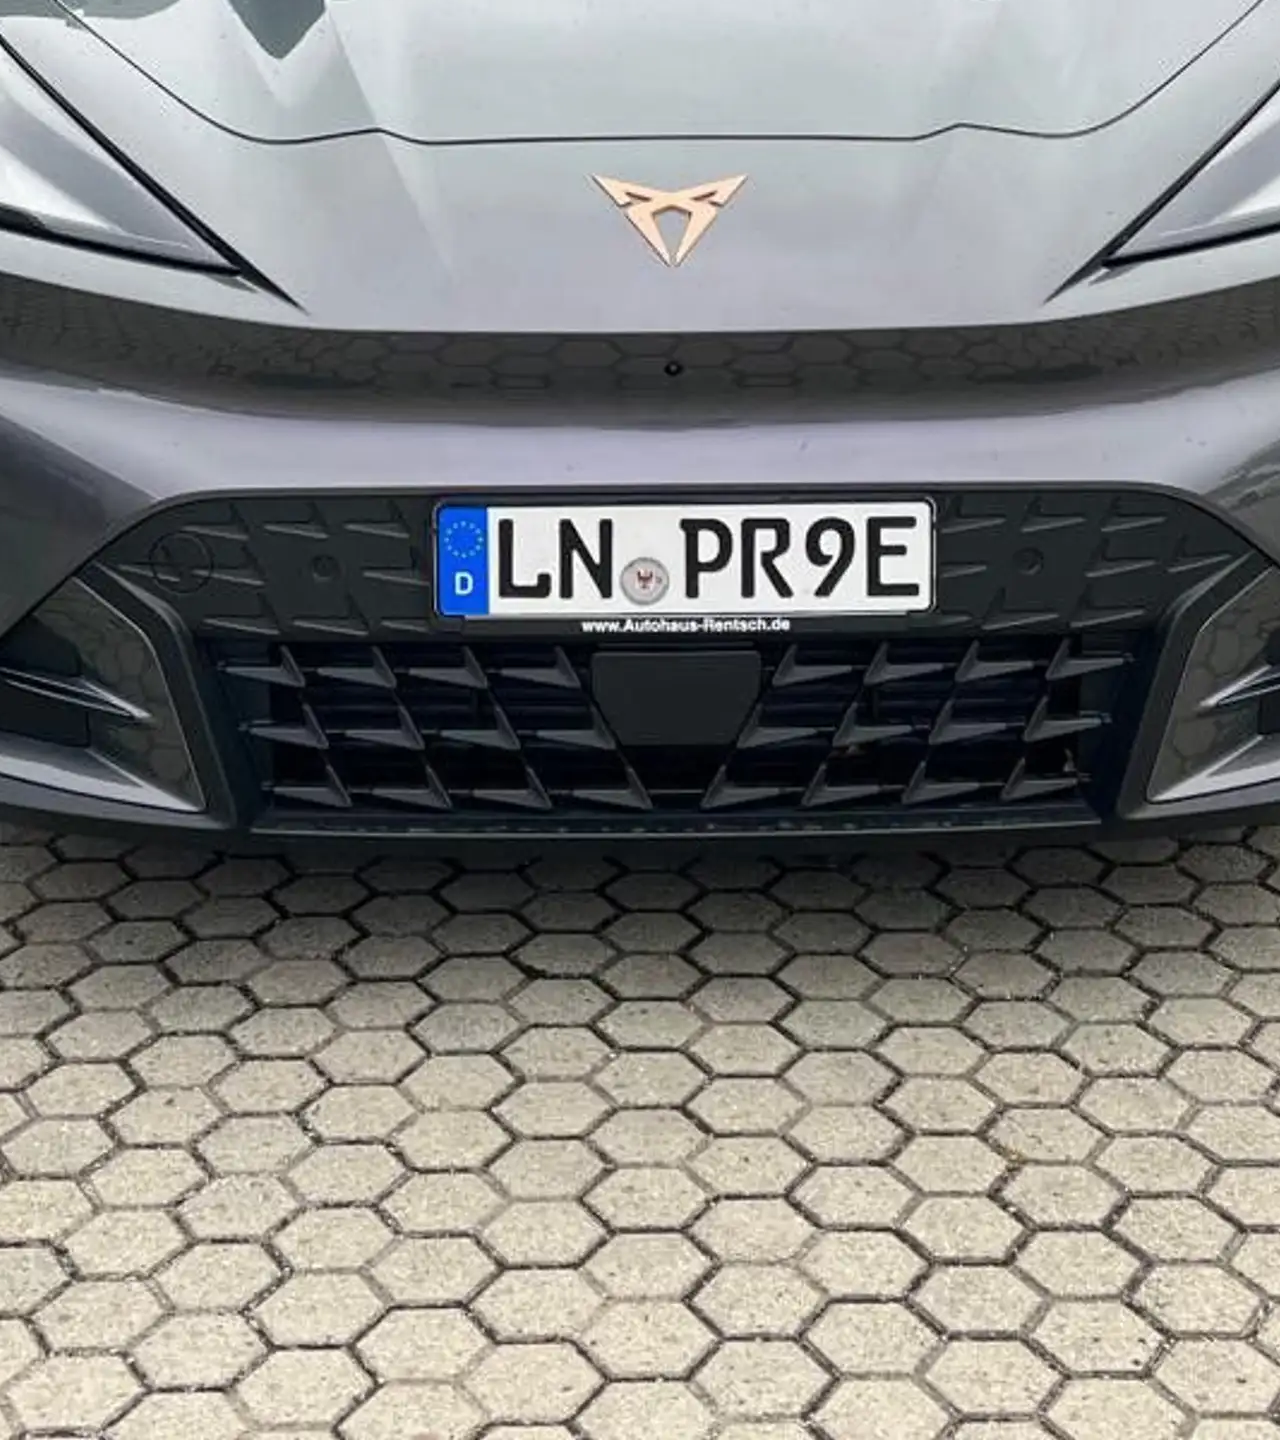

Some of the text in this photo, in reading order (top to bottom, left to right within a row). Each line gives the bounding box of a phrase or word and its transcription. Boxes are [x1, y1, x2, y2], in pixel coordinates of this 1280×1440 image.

[498, 516, 920, 599] LN PR9E
[454, 572, 473, 595] D
[581, 617, 790, 633] www.Autohaus-Rentsch.de
